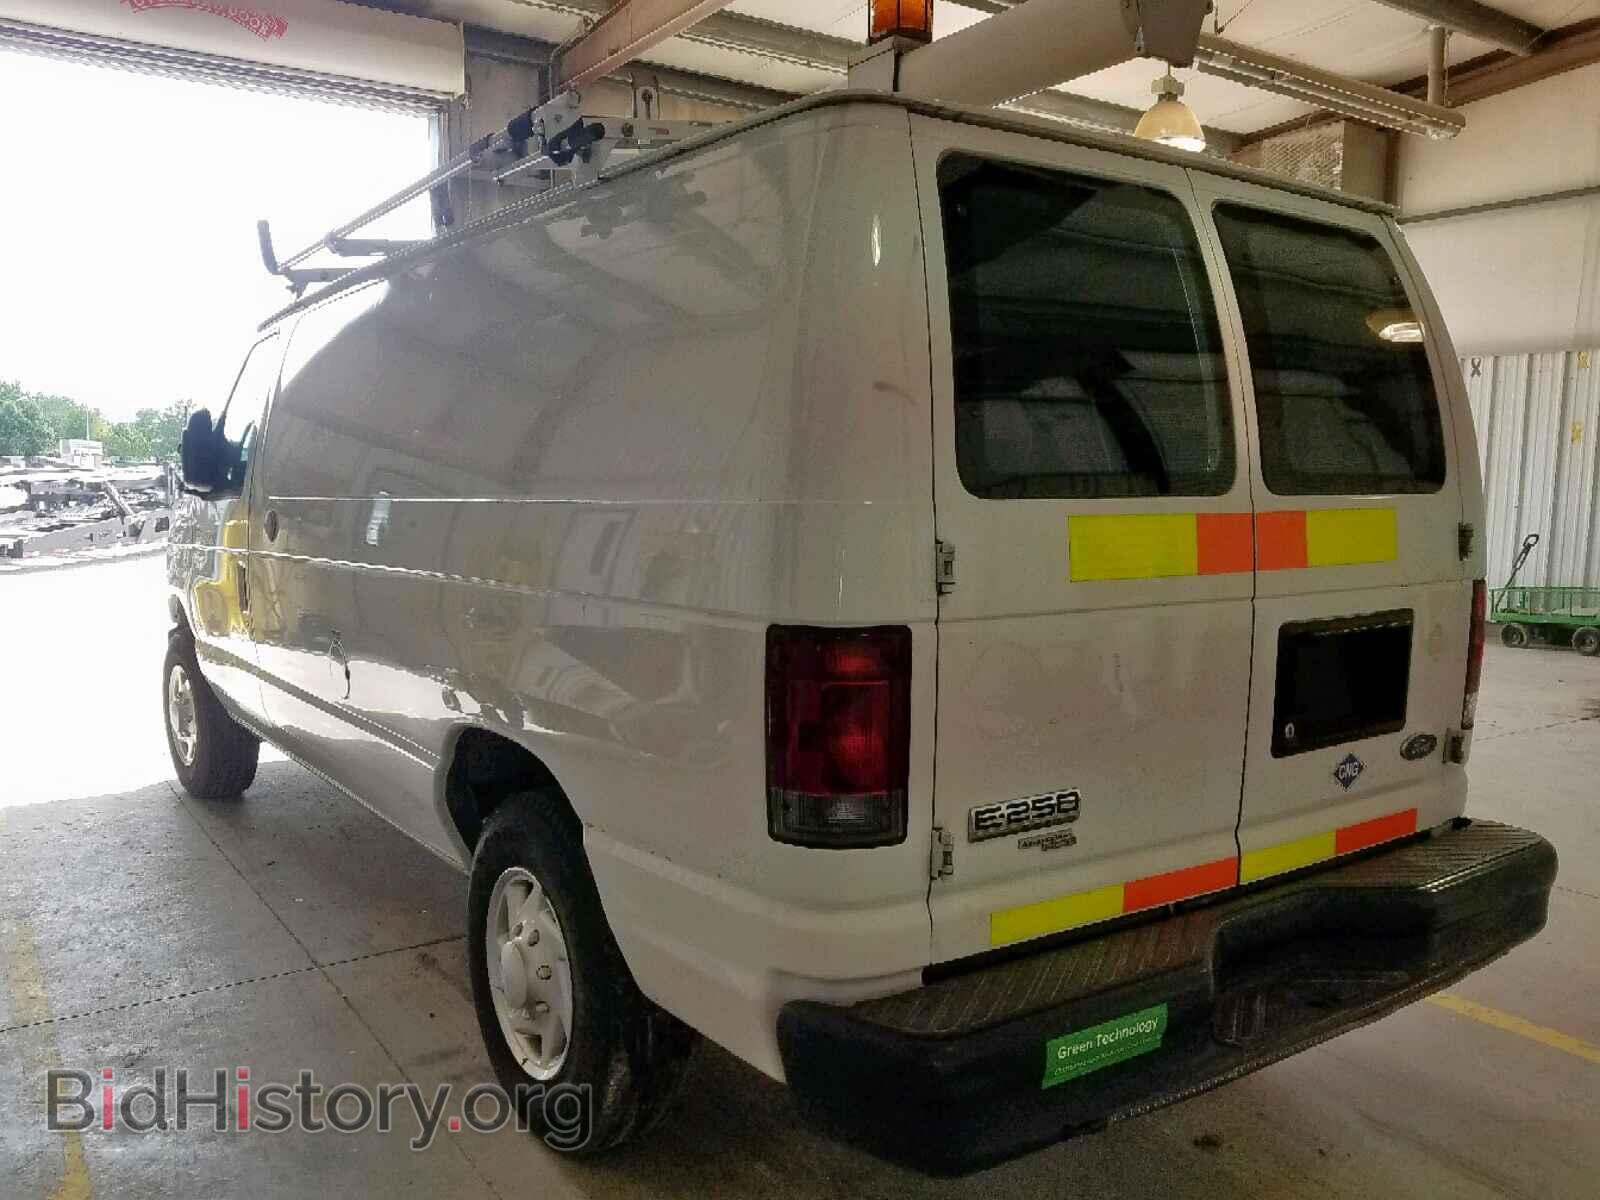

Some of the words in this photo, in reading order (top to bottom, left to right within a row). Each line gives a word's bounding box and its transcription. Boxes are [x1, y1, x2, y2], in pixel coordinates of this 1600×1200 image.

[1338, 761, 1360, 780] CNG
[1057, 1040, 1093, 1059] Green
[1096, 1016, 1159, 1047] Technology
